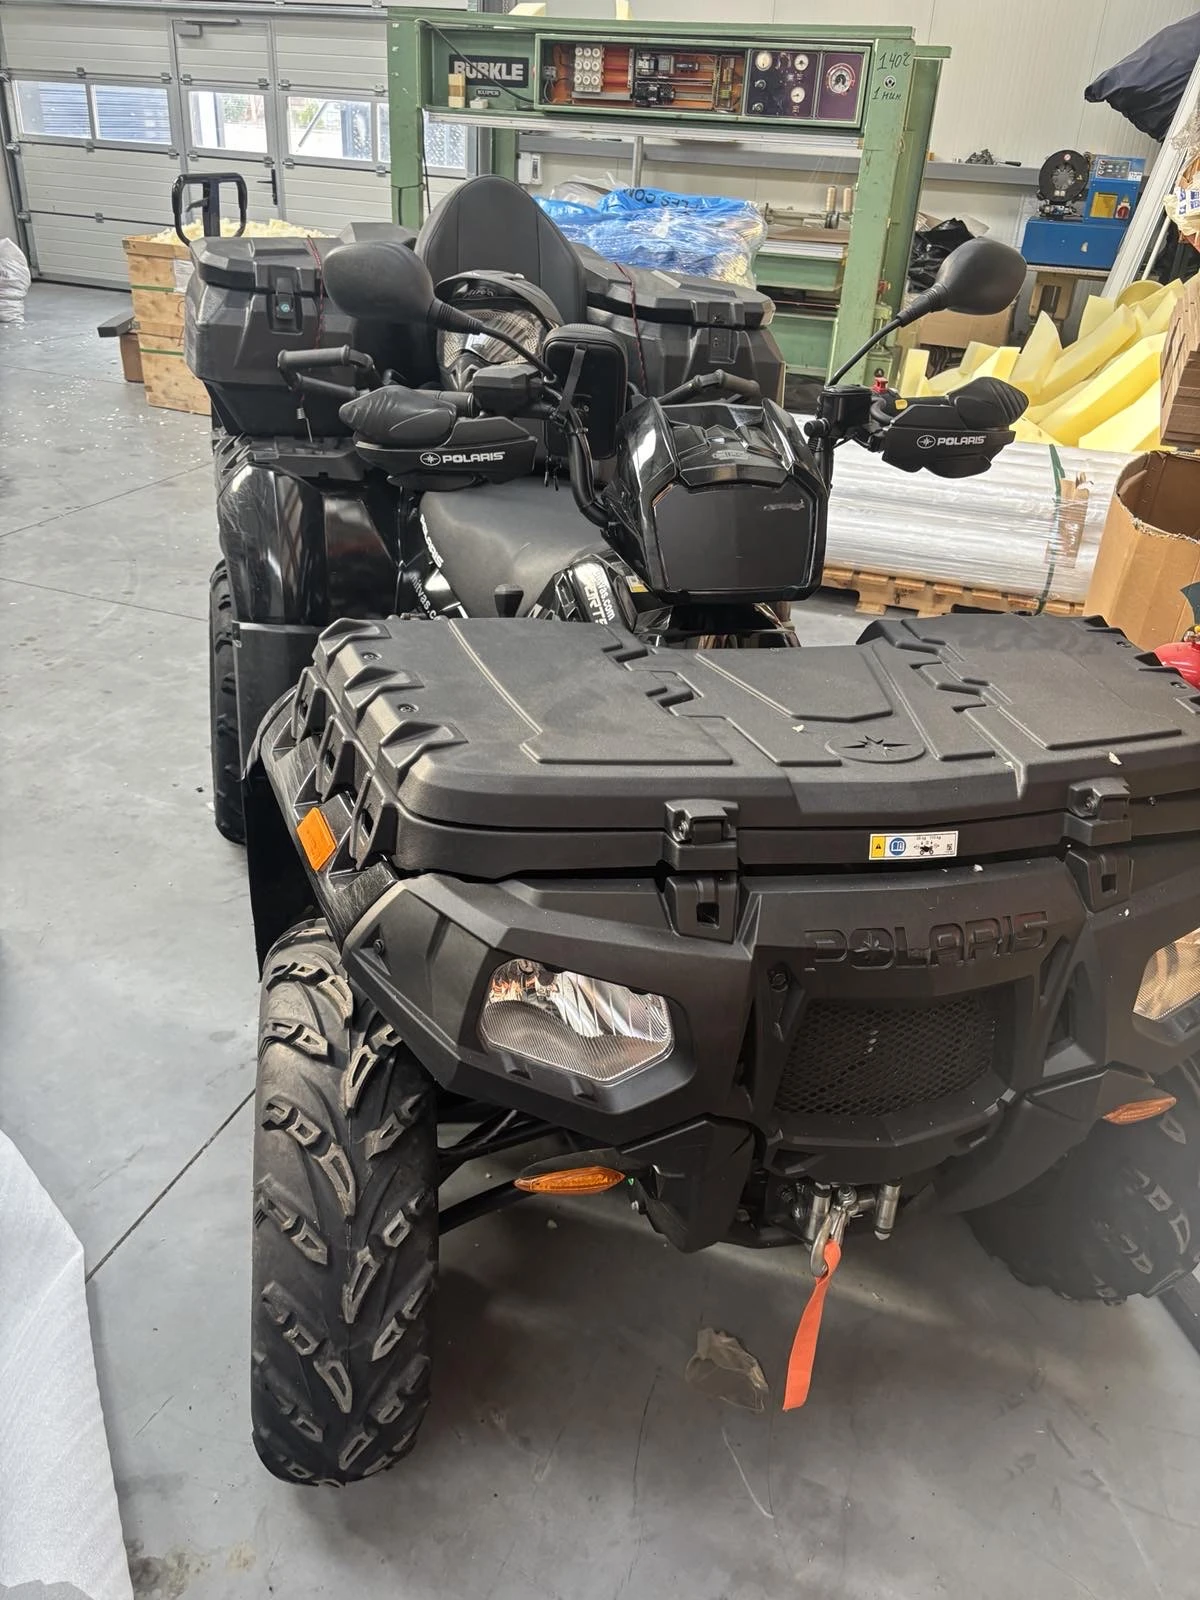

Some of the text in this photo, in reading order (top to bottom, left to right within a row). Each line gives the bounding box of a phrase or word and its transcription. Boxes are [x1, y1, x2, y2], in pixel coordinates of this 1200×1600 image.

[872, 86, 881, 100] 1
[936, 435, 987, 446] POLARIS
[442, 451, 506, 463] POLARIS
[804, 910, 1049, 972] POLARIS
